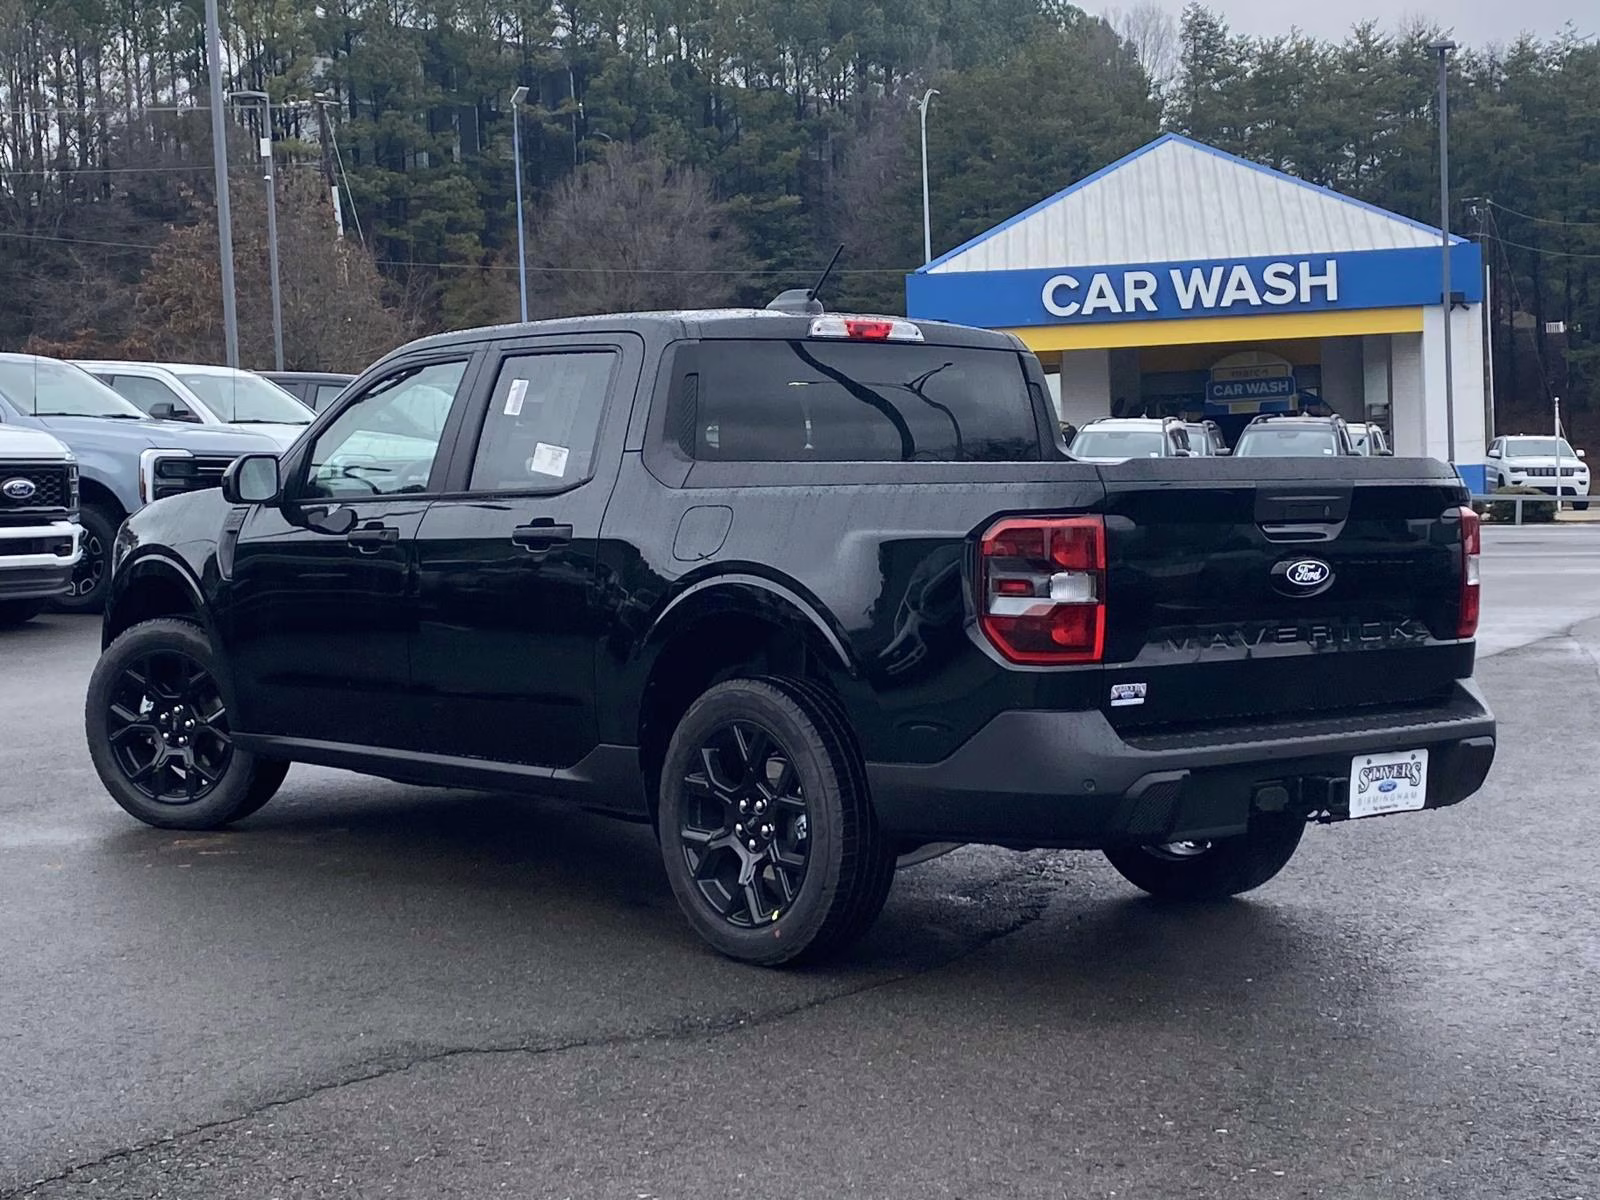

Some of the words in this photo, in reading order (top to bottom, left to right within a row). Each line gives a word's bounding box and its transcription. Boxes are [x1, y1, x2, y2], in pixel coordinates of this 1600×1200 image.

[1041, 270, 1159, 317] CAR
[1168, 258, 1338, 310] WASH
[1213, 383, 1243, 396] CAR
[1246, 380, 1289, 394] WASH
[1295, 564, 1322, 581] Ford
[1164, 618, 1413, 653] MAVERICK
[1358, 761, 1421, 794] STIVERS
